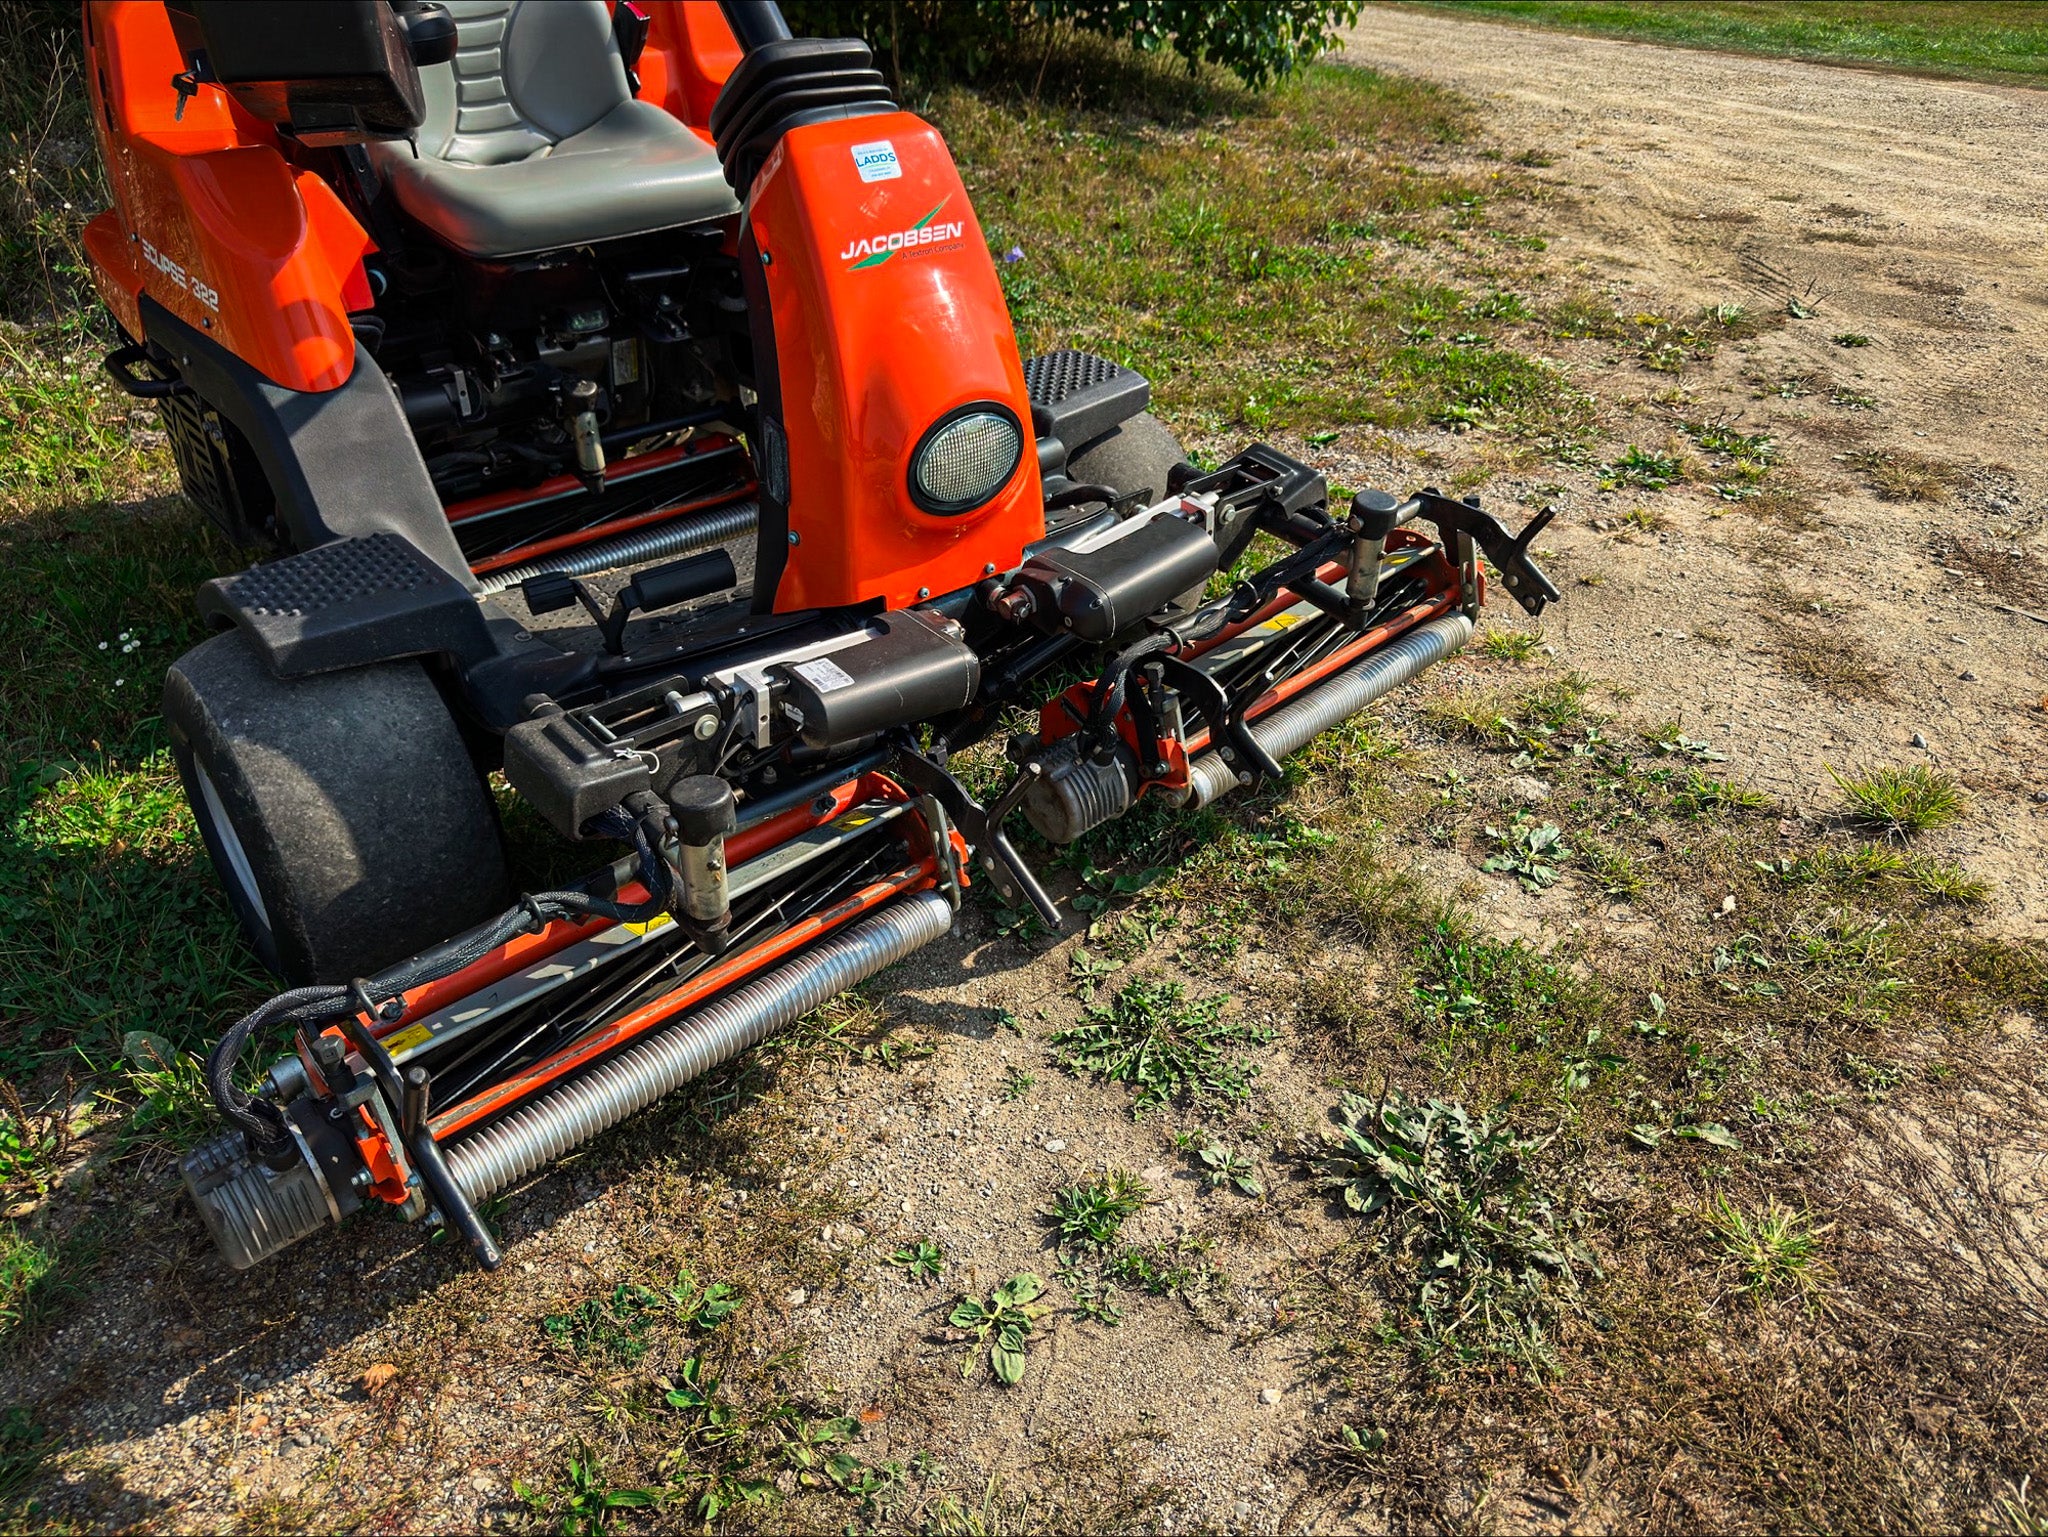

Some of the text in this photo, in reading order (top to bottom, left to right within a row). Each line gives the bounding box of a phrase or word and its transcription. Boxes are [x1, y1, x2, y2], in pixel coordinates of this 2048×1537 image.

[855, 152, 896, 167] LADDS
[841, 221, 963, 260] JACOBSEN
[909, 247, 934, 258] Textron
[934, 242, 964, 254] Company
[191, 276, 219, 313] 322
